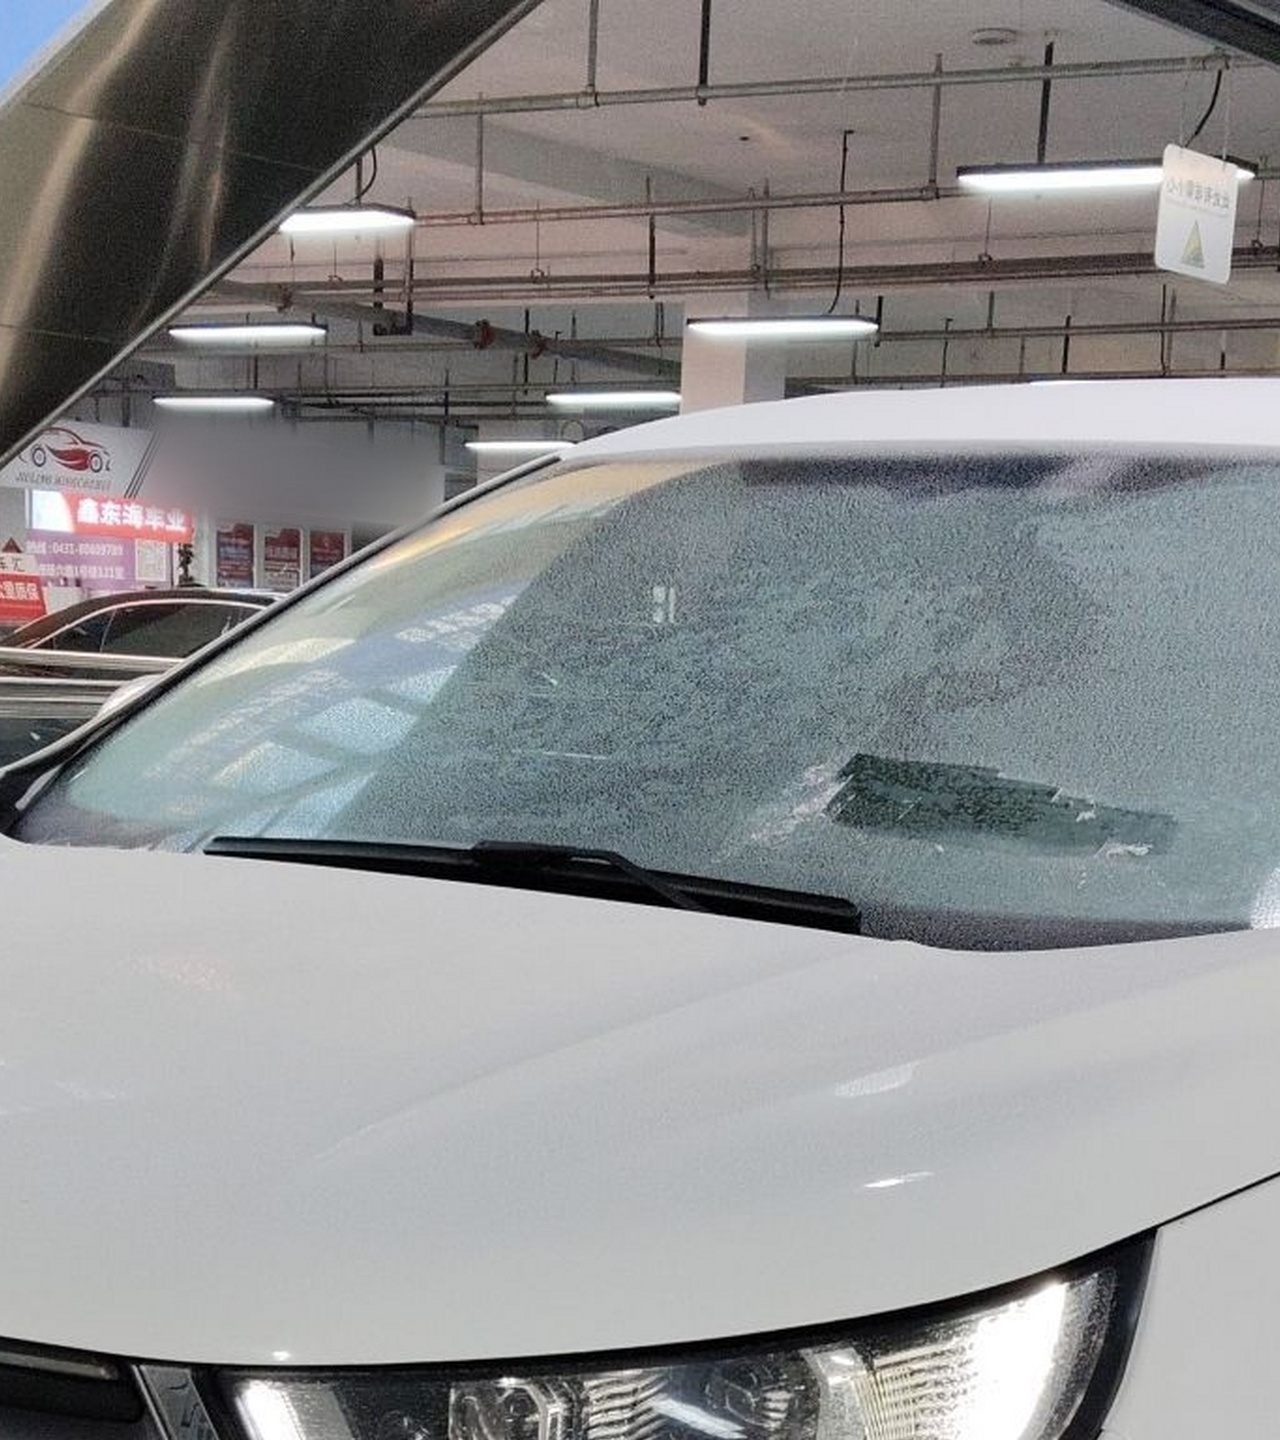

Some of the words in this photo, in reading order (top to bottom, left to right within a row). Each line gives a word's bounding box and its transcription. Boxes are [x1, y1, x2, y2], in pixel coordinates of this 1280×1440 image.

[77, 497, 188, 533] 鑫东海车业
